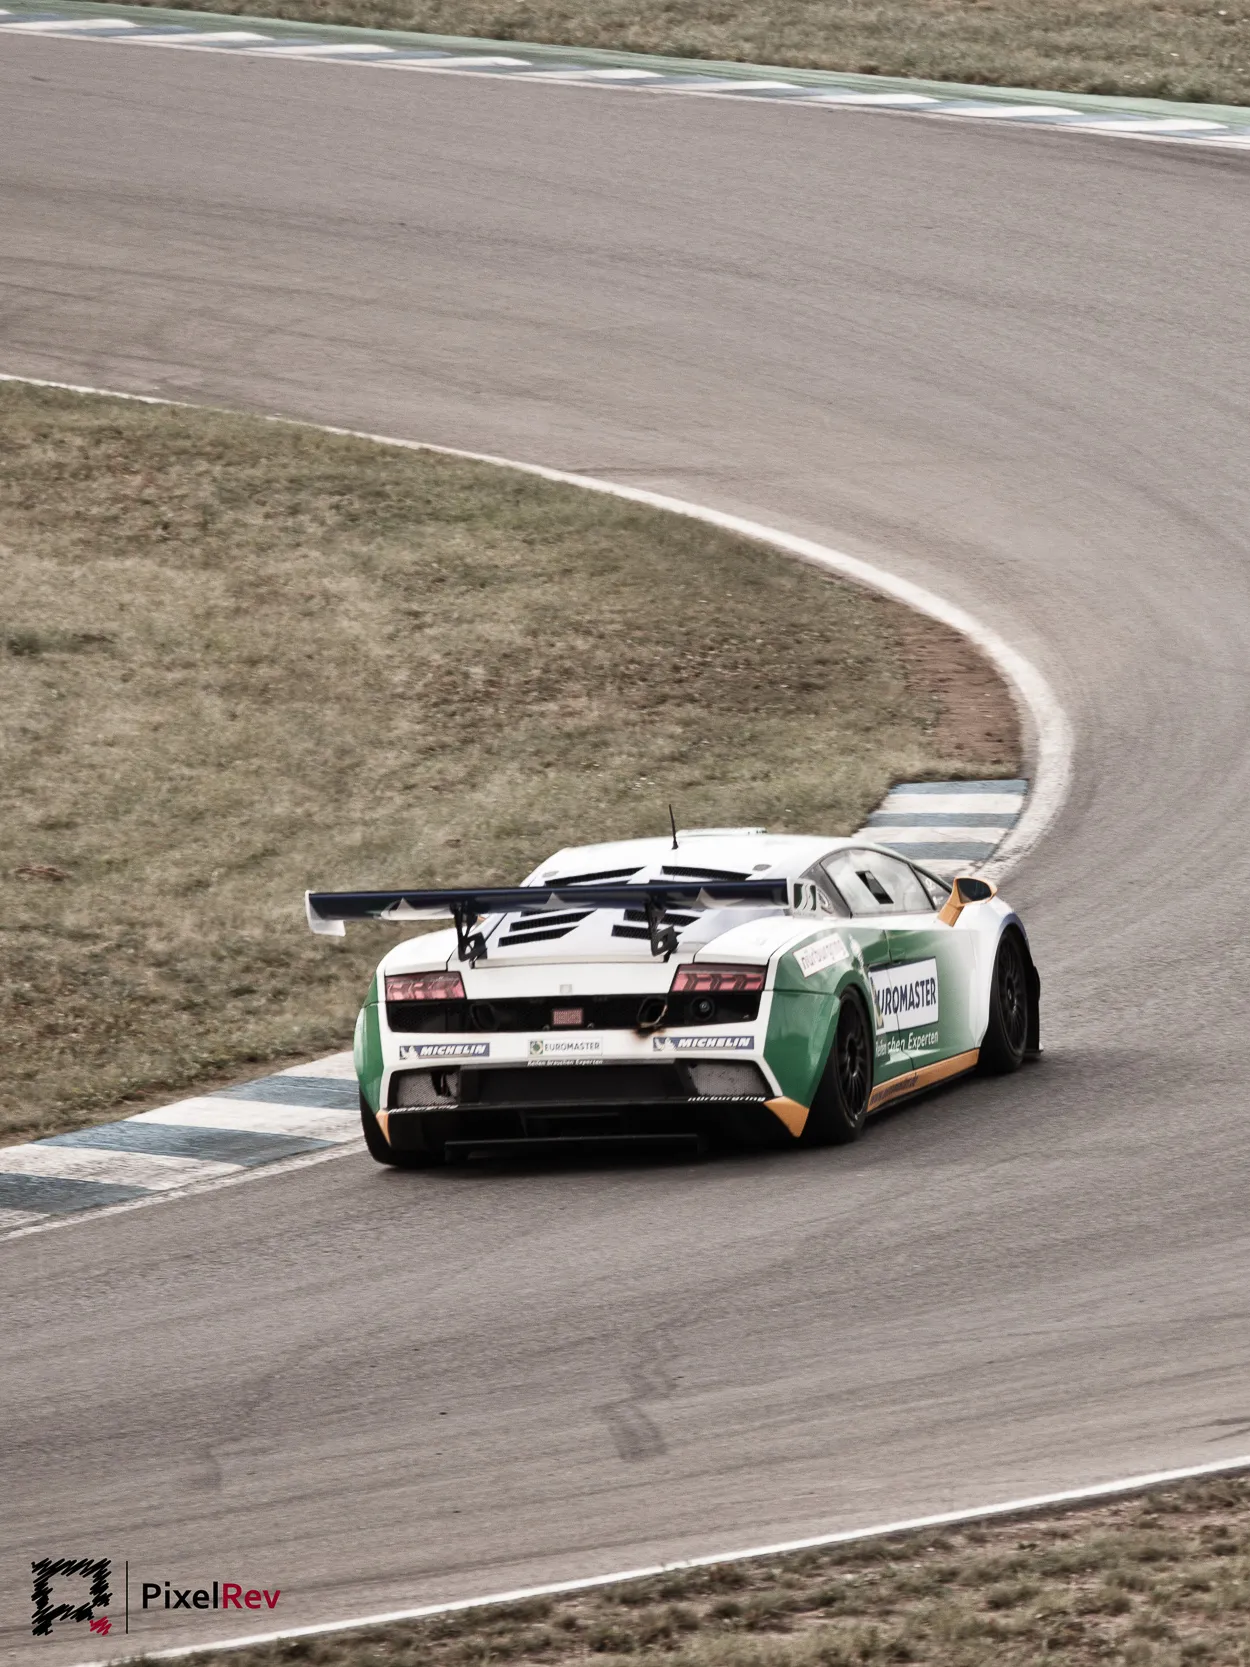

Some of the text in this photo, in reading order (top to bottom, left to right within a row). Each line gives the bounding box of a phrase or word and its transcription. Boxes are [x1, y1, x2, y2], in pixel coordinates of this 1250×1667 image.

[875, 977, 937, 1016] UROMASTER
[544, 1041, 601, 1052] EUROMASTER
[677, 1036, 751, 1048] MICHELIN
[907, 1031, 939, 1051] Experten
[420, 1044, 487, 1057] MICHELIN
